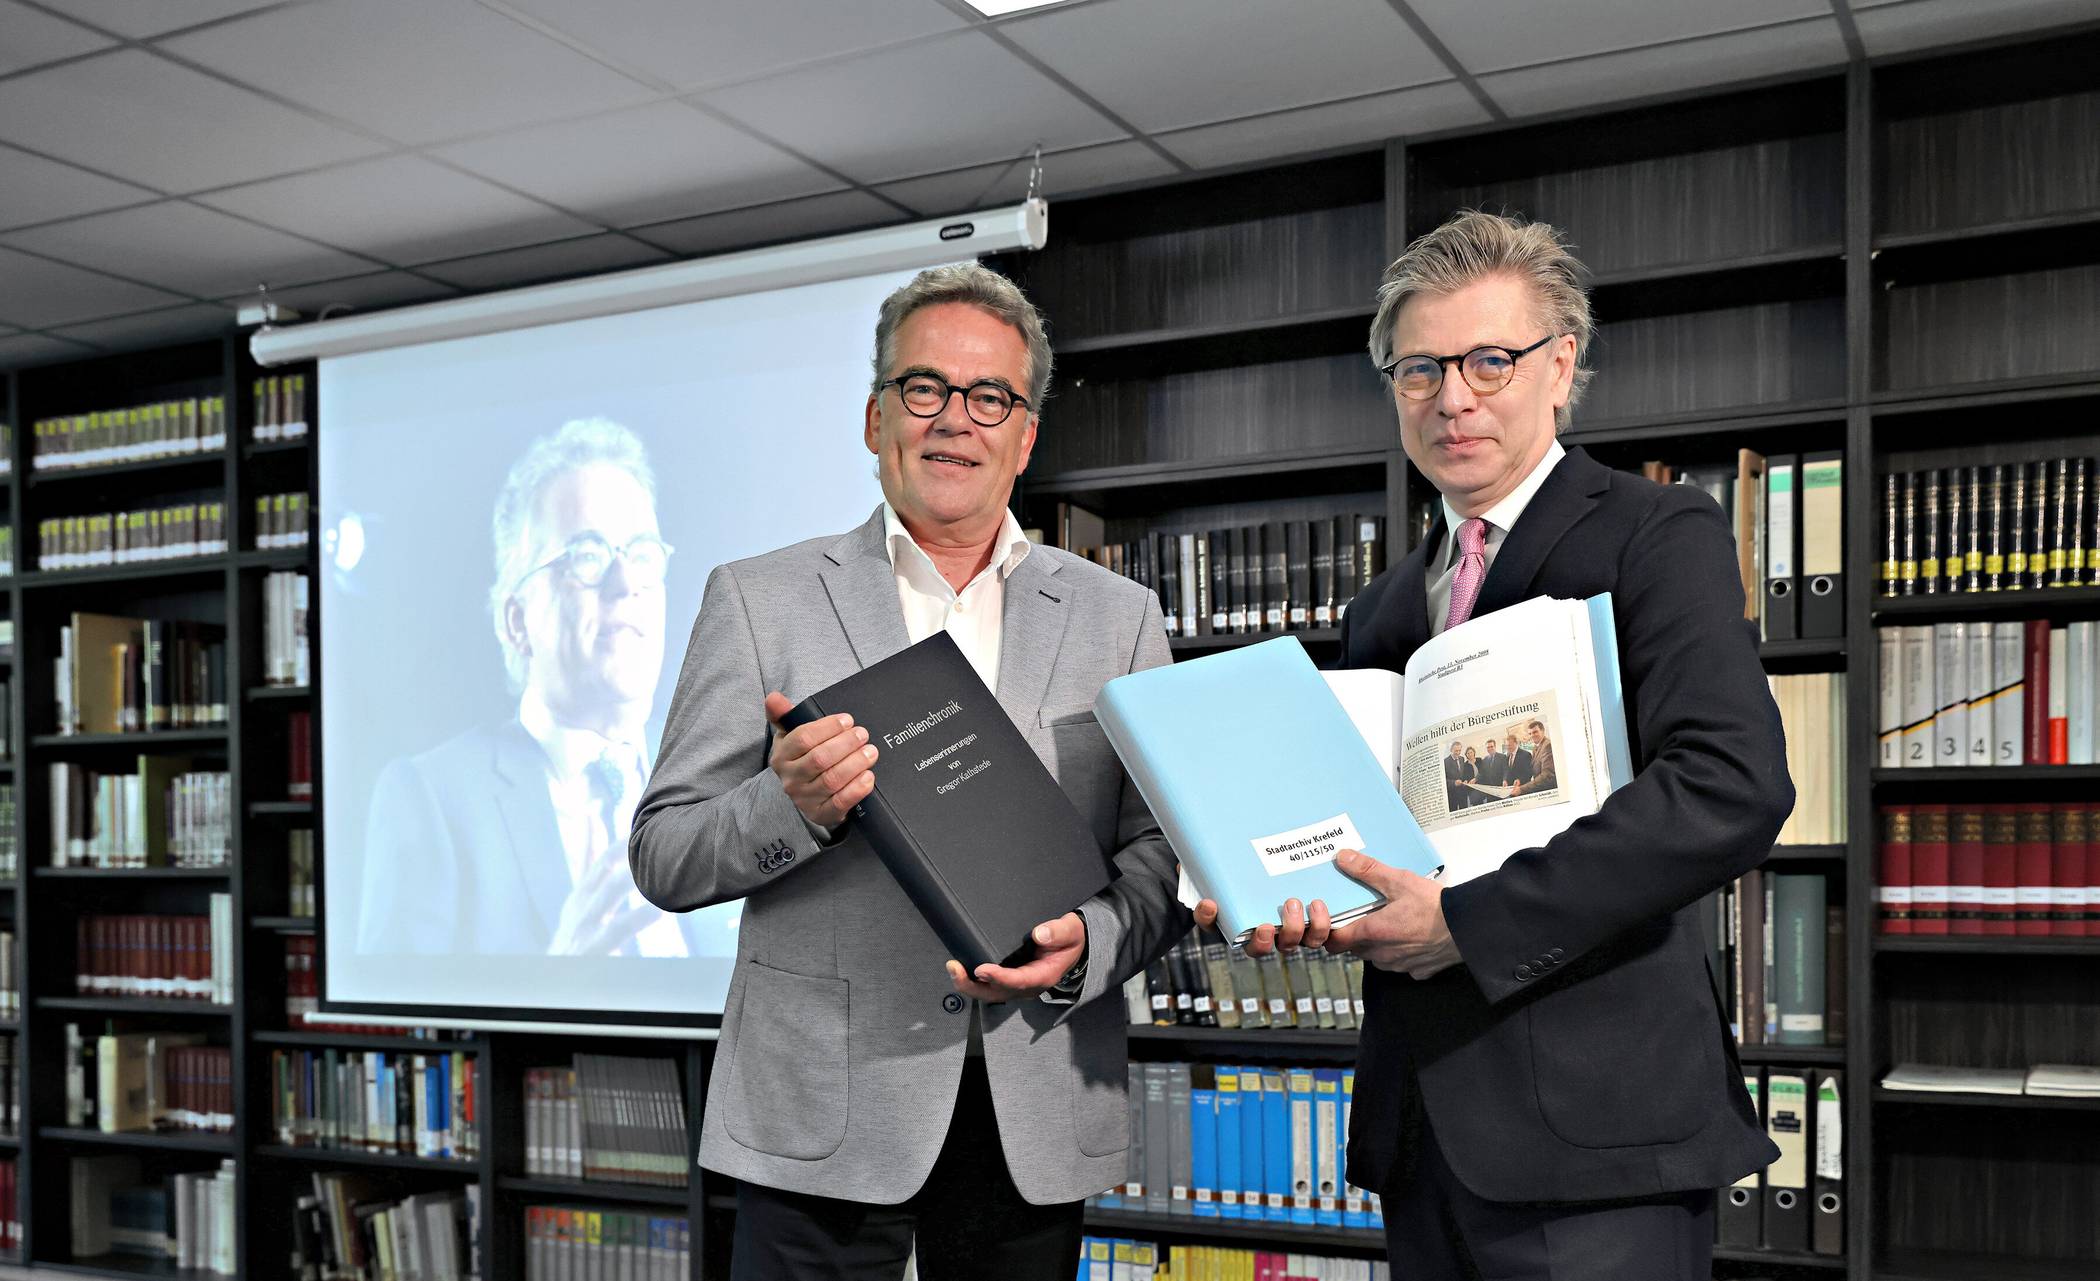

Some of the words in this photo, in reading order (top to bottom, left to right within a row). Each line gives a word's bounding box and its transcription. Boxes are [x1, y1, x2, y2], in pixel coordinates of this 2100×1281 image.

[883, 699, 963, 749] Familienchronik
[1430, 724, 1448, 740] hilft
[1450, 720, 1466, 732] der
[1468, 701, 1539, 728] Bürgerstiftung
[914, 731, 978, 772] Lebenserinnerungen
[1885, 743, 1891, 759] 1
[1910, 742, 1923, 760] 2
[1943, 737, 1956, 756] 3
[1972, 738, 1985, 756] 4
[2000, 741, 2013, 760] 5
[947, 760, 962, 770] von
[936, 776, 960, 795] Gregor
[1265, 837, 1312, 856] Stadtarchiv
[1312, 827, 1344, 844] Krefeld
[1289, 843, 1335, 862] 40/115/50
